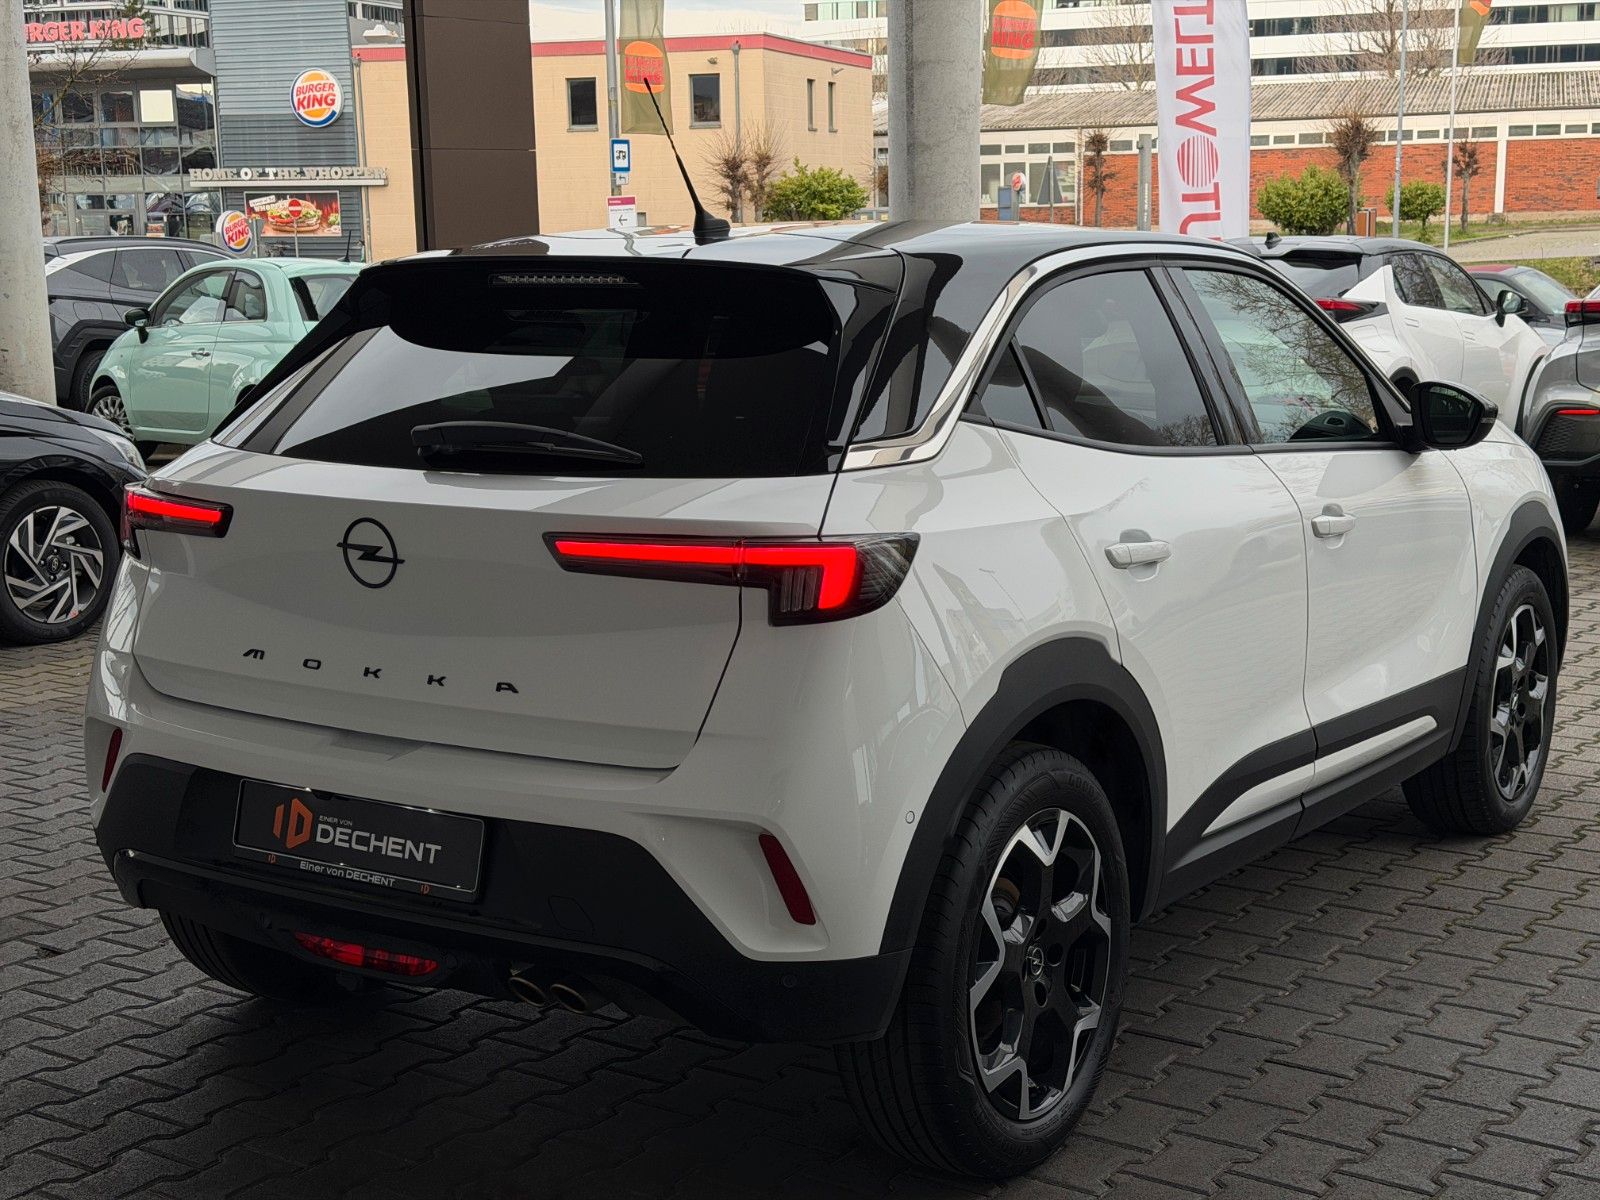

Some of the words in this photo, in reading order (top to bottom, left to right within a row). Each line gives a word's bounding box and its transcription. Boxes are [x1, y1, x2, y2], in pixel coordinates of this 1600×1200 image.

[24, 22, 84, 42] RGER
[88, 18, 145, 39] KING
[296, 82, 335, 97] BURGER
[296, 93, 336, 111] KING
[188, 167, 237, 180] HOME
[240, 167, 263, 180] OF
[265, 167, 300, 180] THE
[301, 166, 387, 180] WHOPPER
[227, 225, 250, 245] KING
[243, 648, 519, 694] MOKKA
[319, 815, 338, 824] EINER
[340, 819, 353, 827] VON
[315, 823, 442, 864] DECHENT
[300, 860, 325, 875] Einer
[326, 867, 345, 878] von
[345, 869, 396, 888] DECHENT
